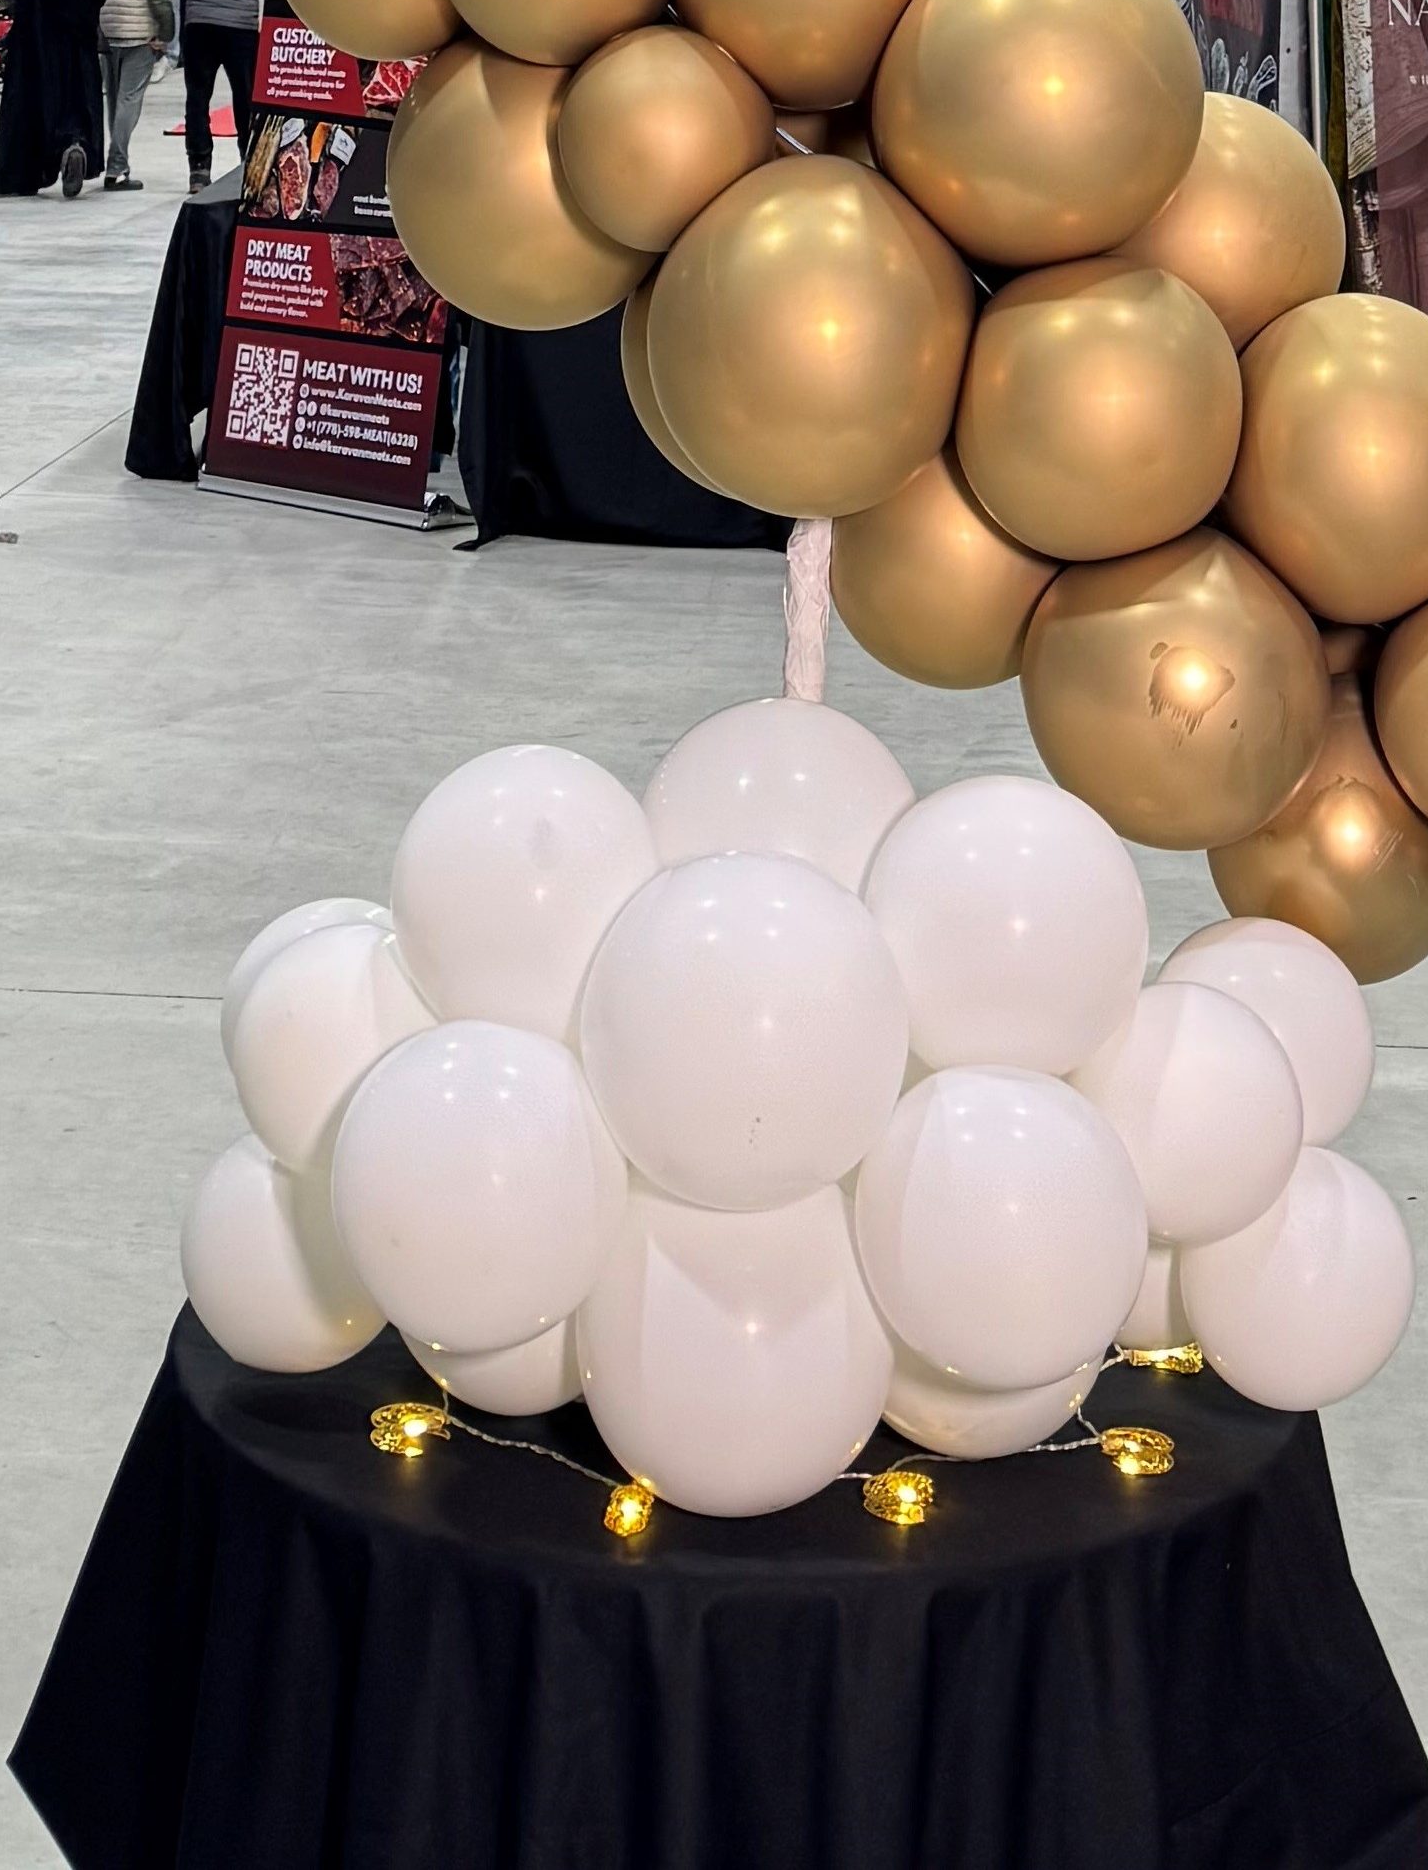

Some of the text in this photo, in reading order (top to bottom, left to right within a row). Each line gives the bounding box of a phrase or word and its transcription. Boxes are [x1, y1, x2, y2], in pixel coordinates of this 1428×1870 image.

[273, 27, 326, 46] CUSTOM
[271, 45, 336, 66] BUTCHERY
[247, 239, 311, 261] DRY MEAT
[245, 258, 312, 282] PRODUCTS
[302, 359, 423, 395] MEAT WITH US!
